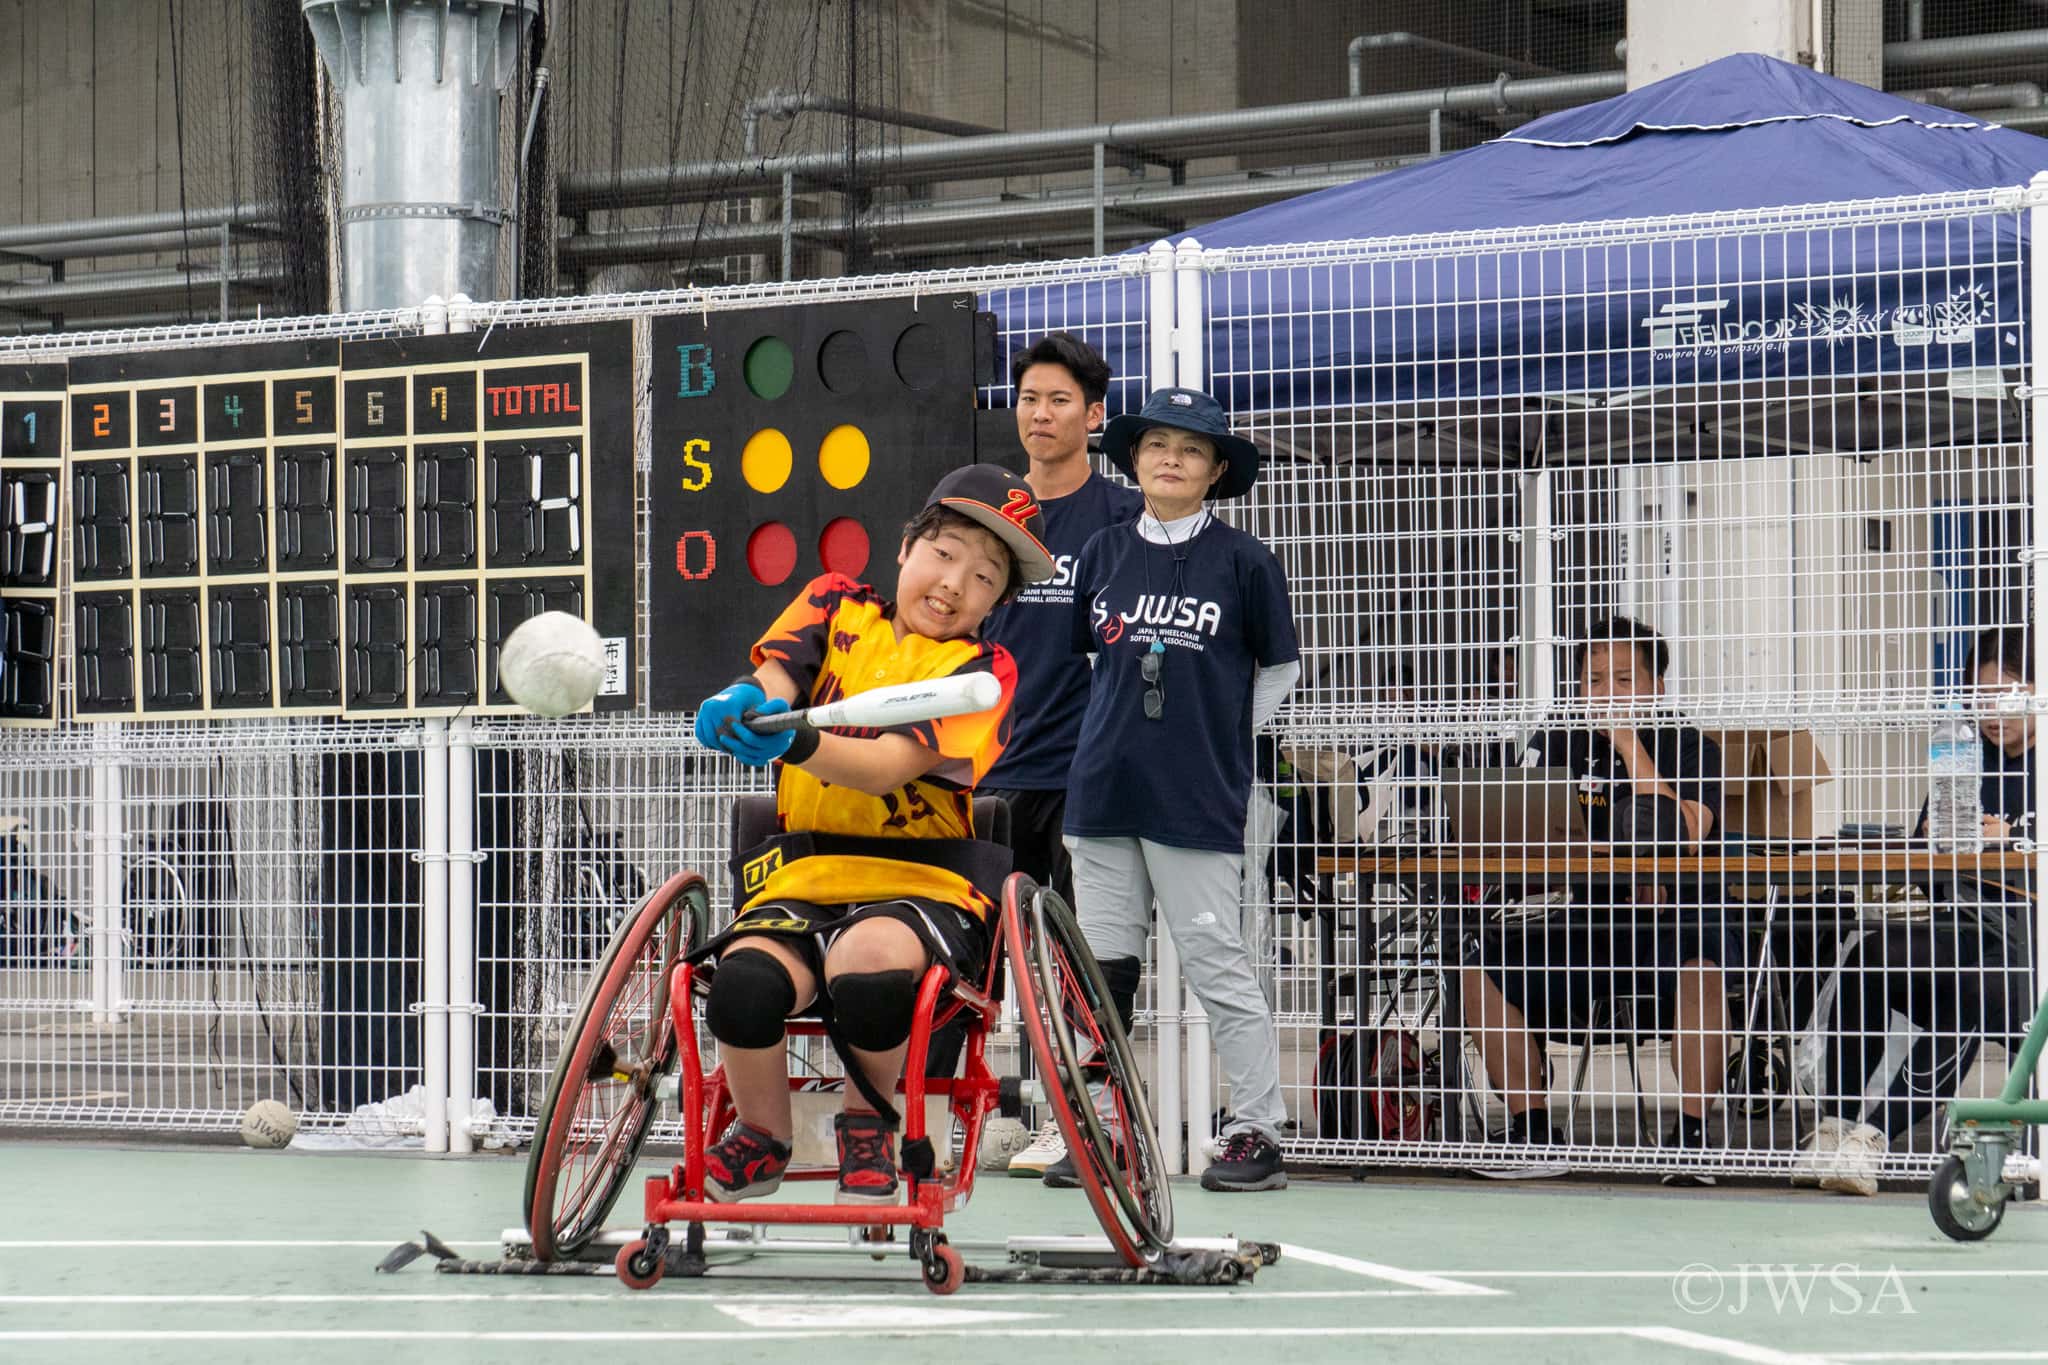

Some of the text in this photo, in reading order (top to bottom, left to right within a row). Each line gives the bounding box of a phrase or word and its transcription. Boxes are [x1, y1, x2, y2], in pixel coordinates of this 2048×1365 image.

[676, 343, 716, 399] B
[1704, 347, 1719, 358] by
[23, 383, 580, 445] 1 2 3 4 5 6 7 TOTAL
[682, 438, 713, 491] S
[14, 451, 580, 576] 4 4
[676, 530, 717, 580] O
[1120, 594, 1221, 636] JWSA
[1159, 628, 1200, 642] WHEELCHAIR
[1163, 638, 1204, 652] ASSOCIATION
[880, 781, 936, 829] 25
[1577, 793, 1607, 808] APAN
